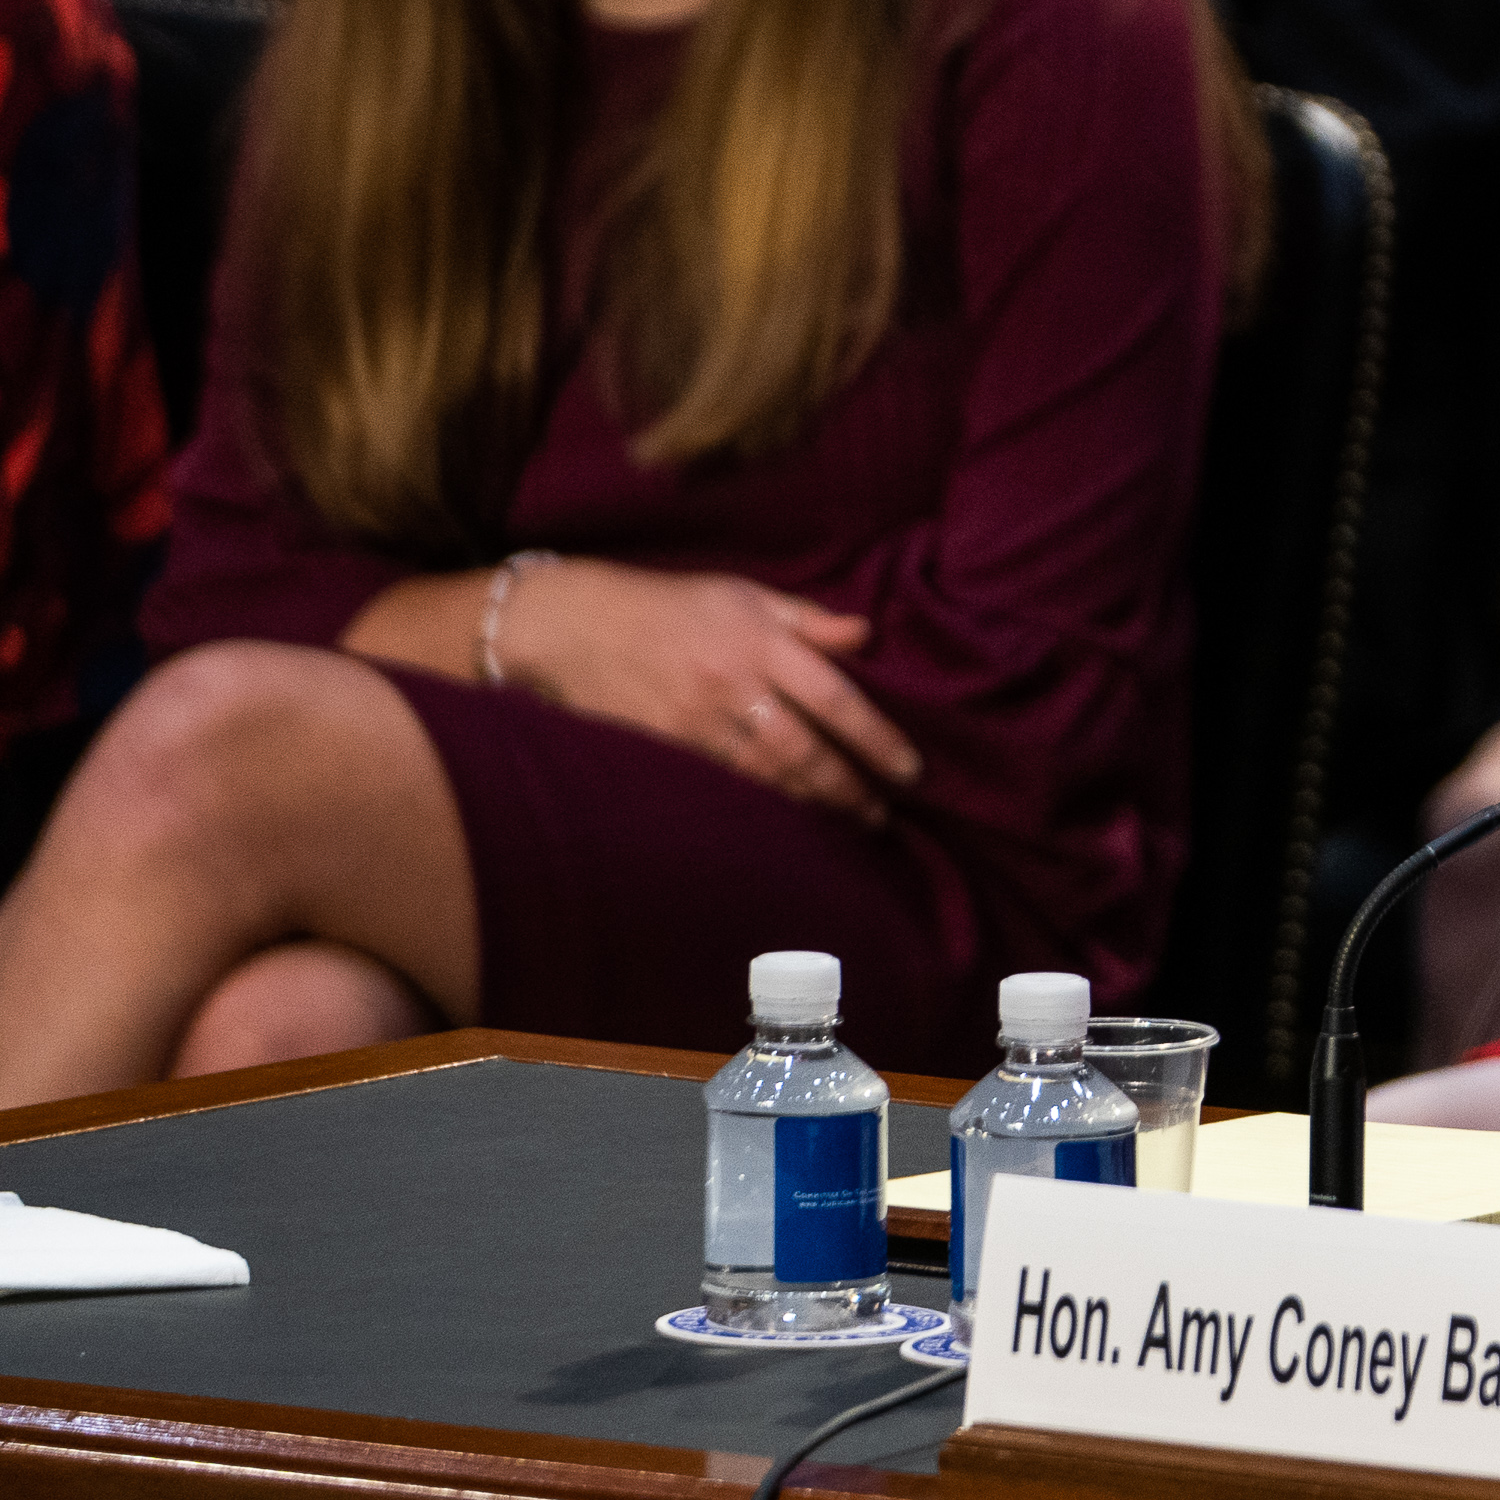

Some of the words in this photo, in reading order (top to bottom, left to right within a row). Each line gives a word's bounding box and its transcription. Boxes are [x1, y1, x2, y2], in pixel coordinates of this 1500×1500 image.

[1012, 1267, 1120, 1364] Hon.
[1137, 1283, 1253, 1402] Amy
[1269, 1295, 1427, 1422] Coney
